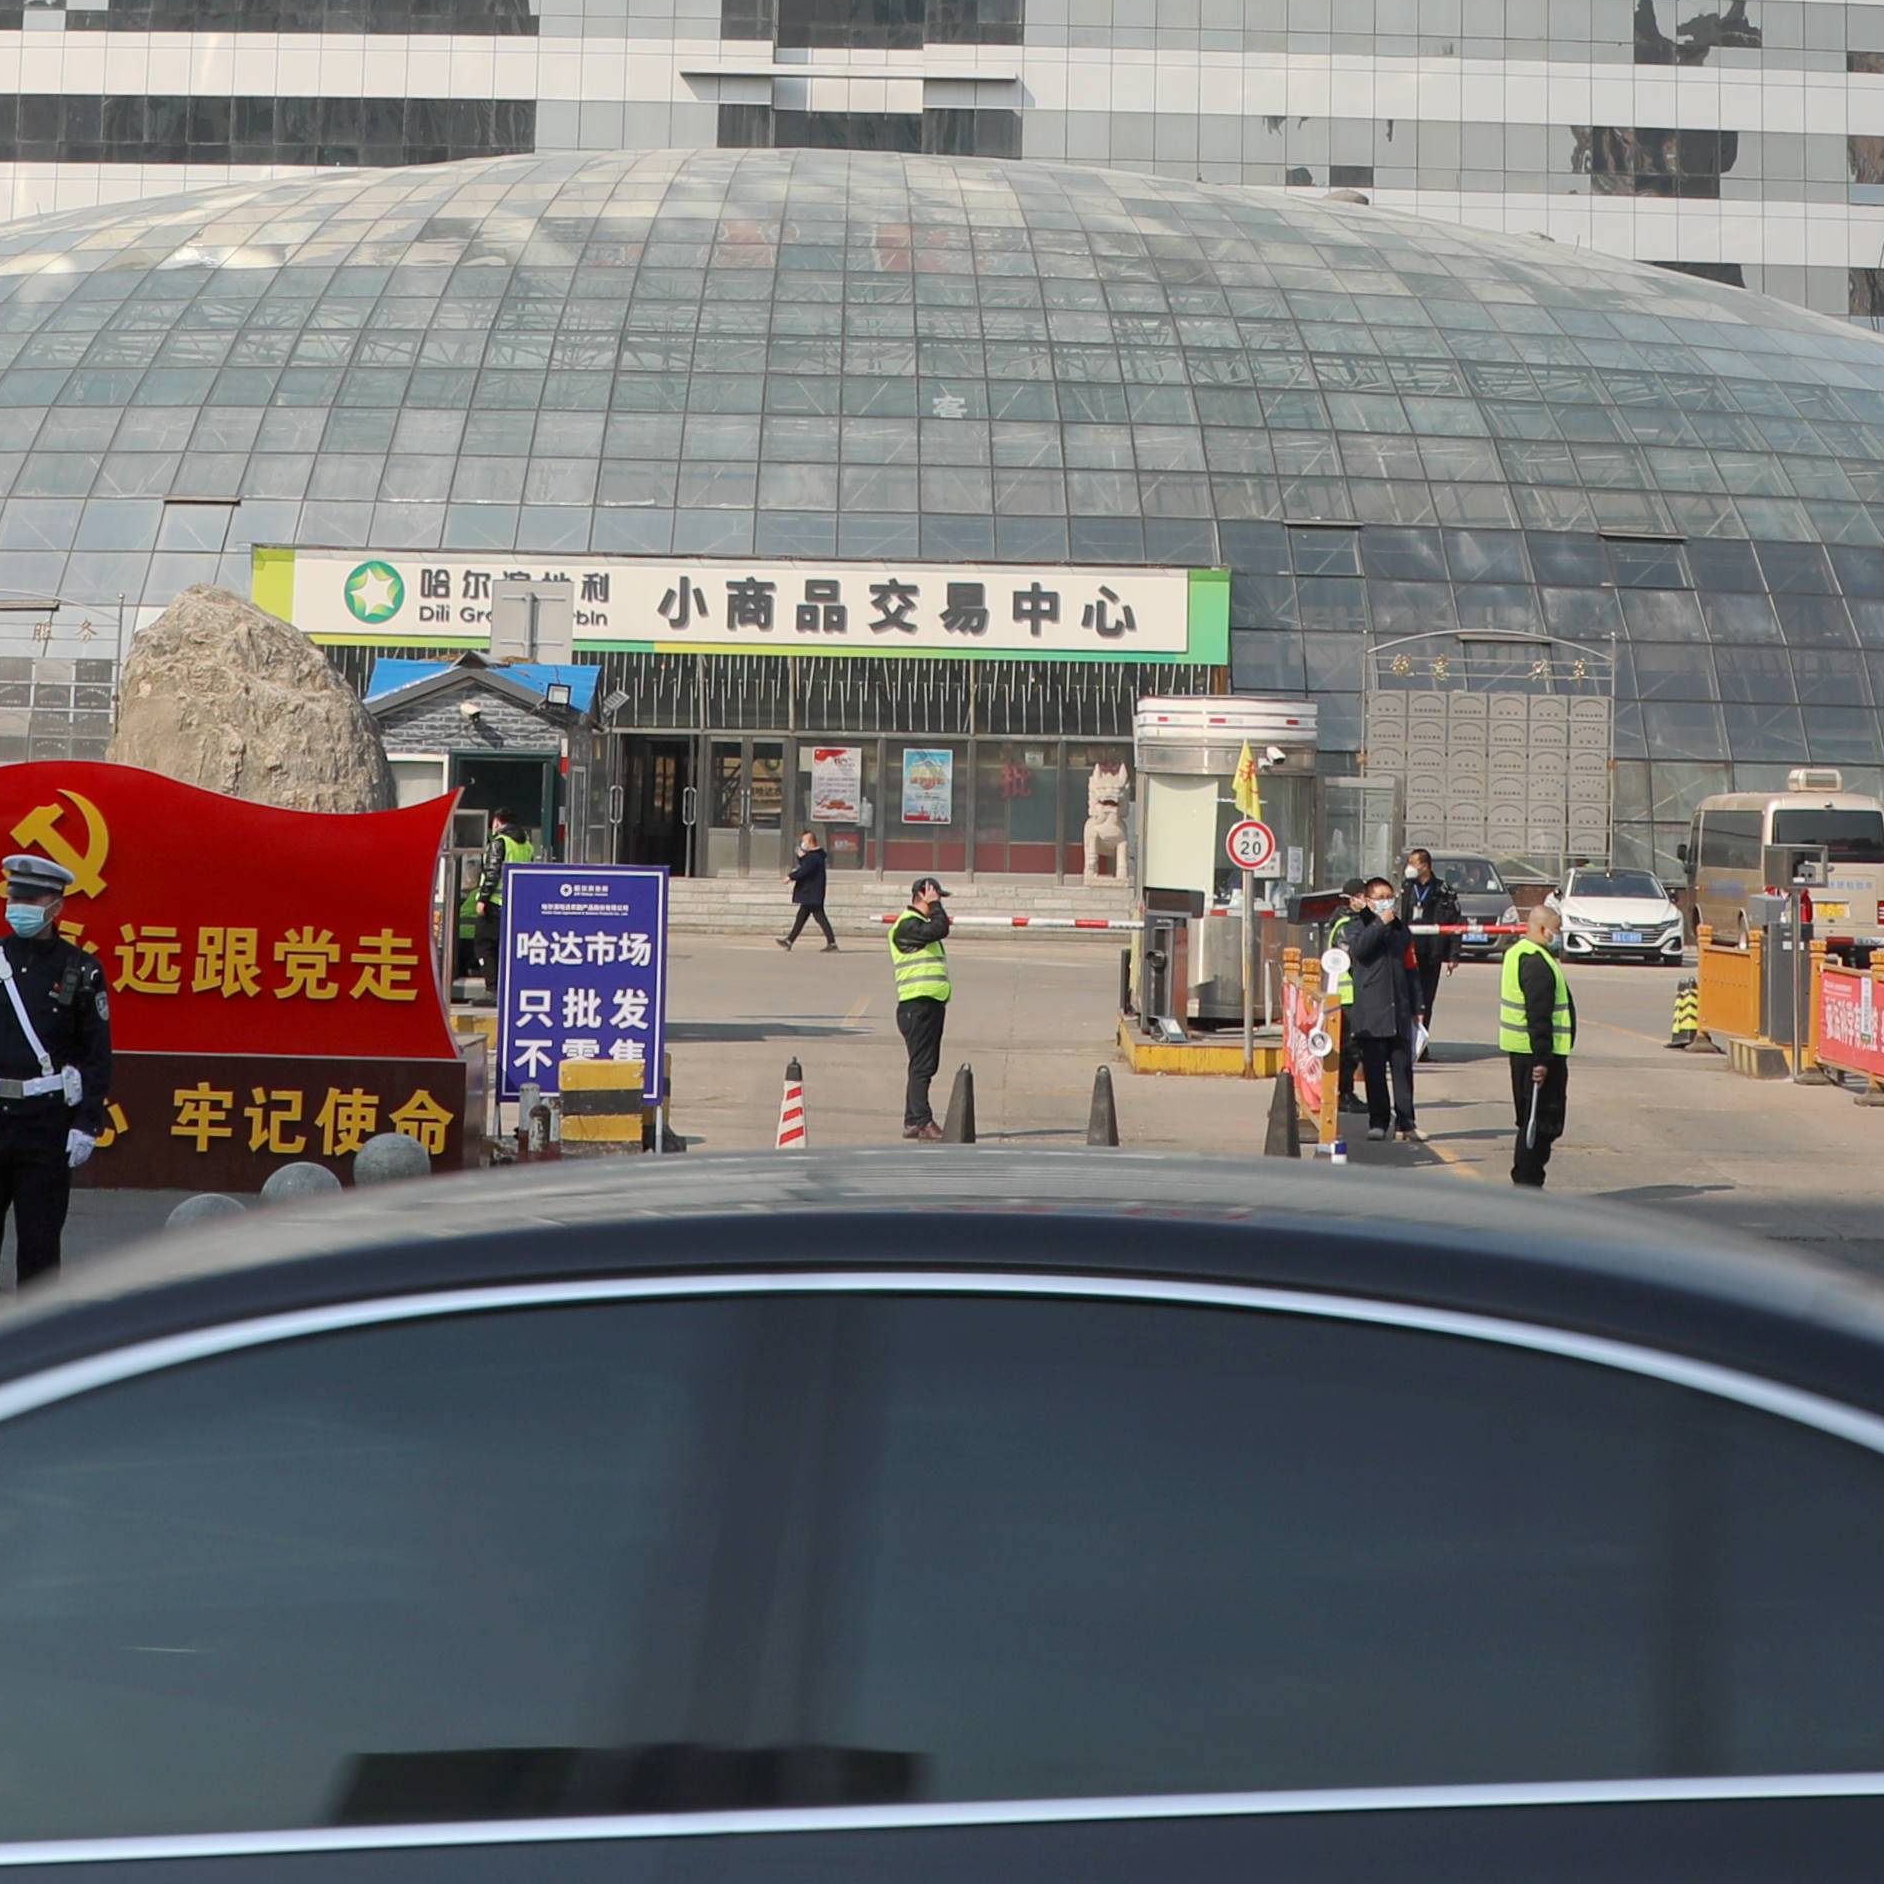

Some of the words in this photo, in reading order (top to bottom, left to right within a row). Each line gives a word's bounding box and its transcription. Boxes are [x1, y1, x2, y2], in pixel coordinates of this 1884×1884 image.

[420, 569, 610, 603] 哈尔利
[419, 604, 451, 623] Dili
[657, 575, 1137, 639] 小商品交易中心
[1240, 840, 1262, 856] 20
[57, 919, 421, 1003] 远跟党走
[515, 930, 653, 967] 哈达市场
[515, 987, 651, 1031] 只批发
[170, 1081, 455, 1157] 牢记使命
